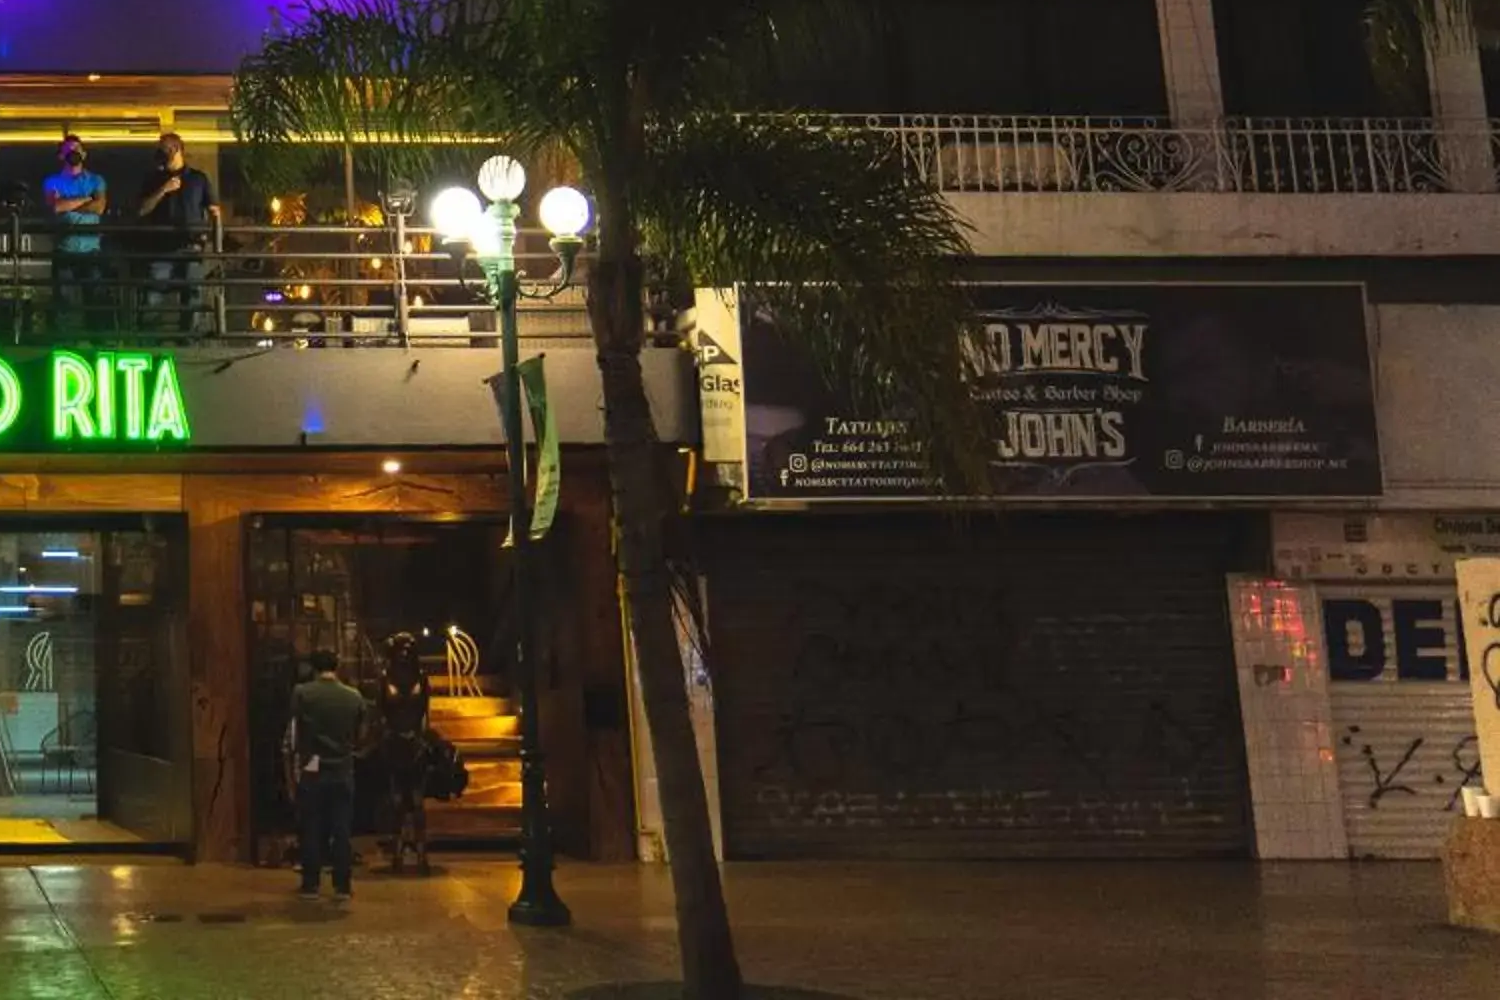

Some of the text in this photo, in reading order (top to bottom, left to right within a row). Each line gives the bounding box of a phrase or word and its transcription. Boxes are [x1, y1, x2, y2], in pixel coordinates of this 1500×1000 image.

[1018, 323, 1150, 382] MERCY
[53, 351, 190, 441] RITA
[996, 407, 1126, 458] JOHN'S
[1322, 599, 1469, 681] DE
